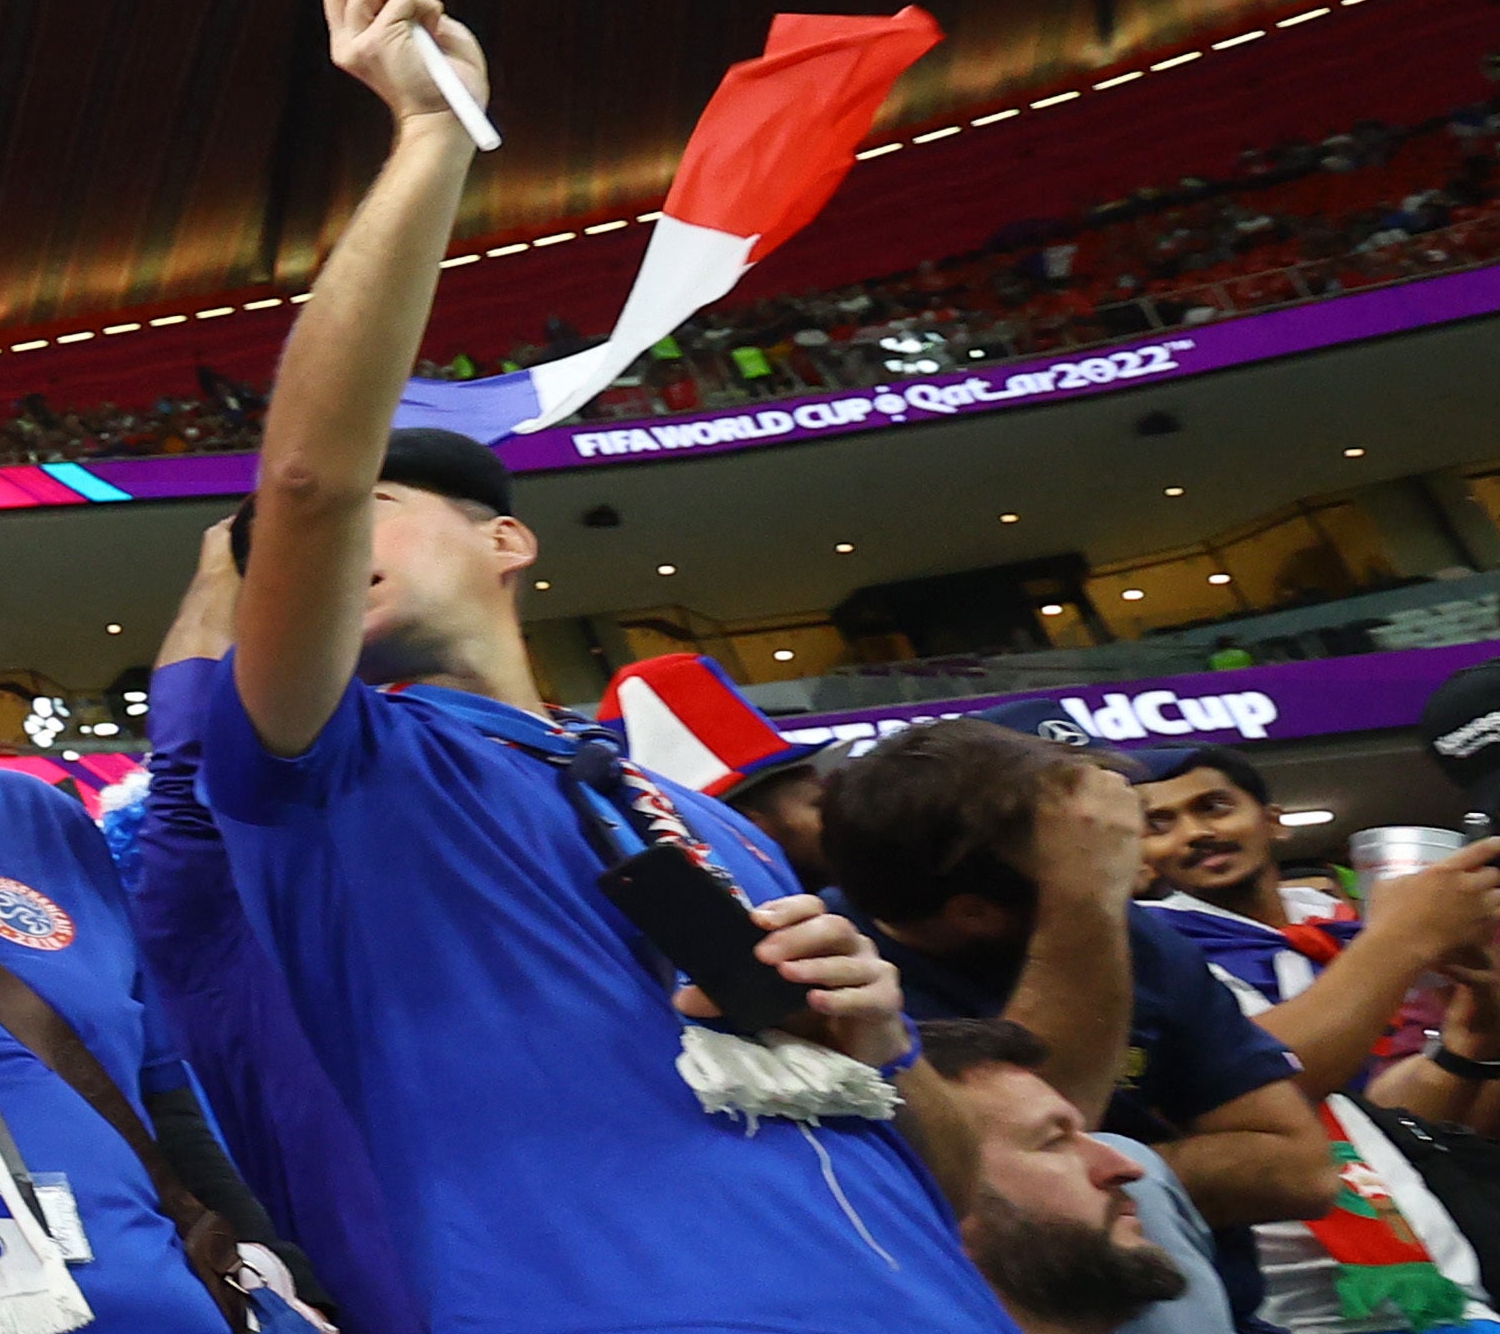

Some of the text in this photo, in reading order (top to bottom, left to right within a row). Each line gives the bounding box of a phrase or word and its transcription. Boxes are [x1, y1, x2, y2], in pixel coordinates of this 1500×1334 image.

[572, 428, 661, 457] FIFA
[650, 410, 795, 449] WORLD
[792, 398, 873, 429] CUP
